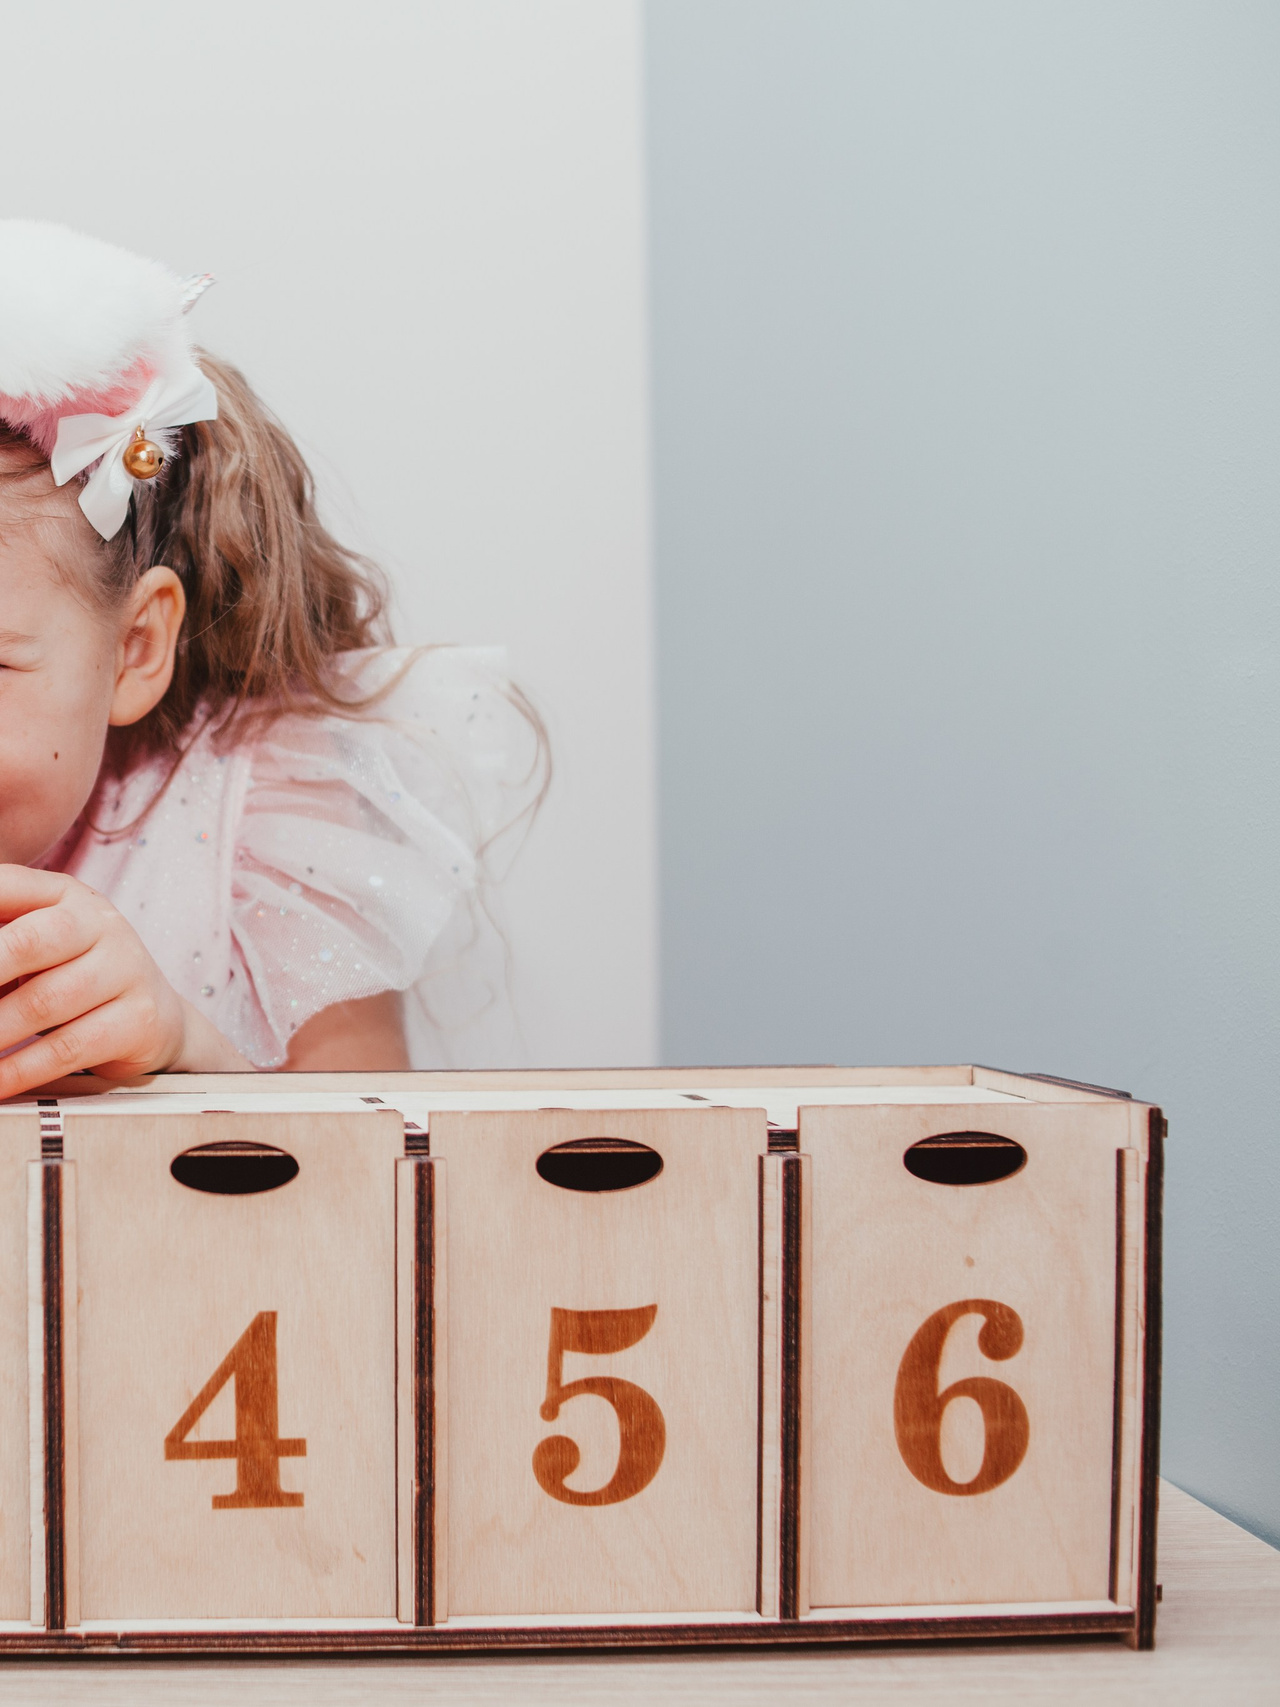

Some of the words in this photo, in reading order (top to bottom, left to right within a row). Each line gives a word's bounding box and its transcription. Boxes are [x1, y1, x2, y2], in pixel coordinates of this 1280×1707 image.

[163, 1310, 308, 1510] 4
[531, 1303, 667, 1507] 5
[893, 1297, 1031, 1497] 6
